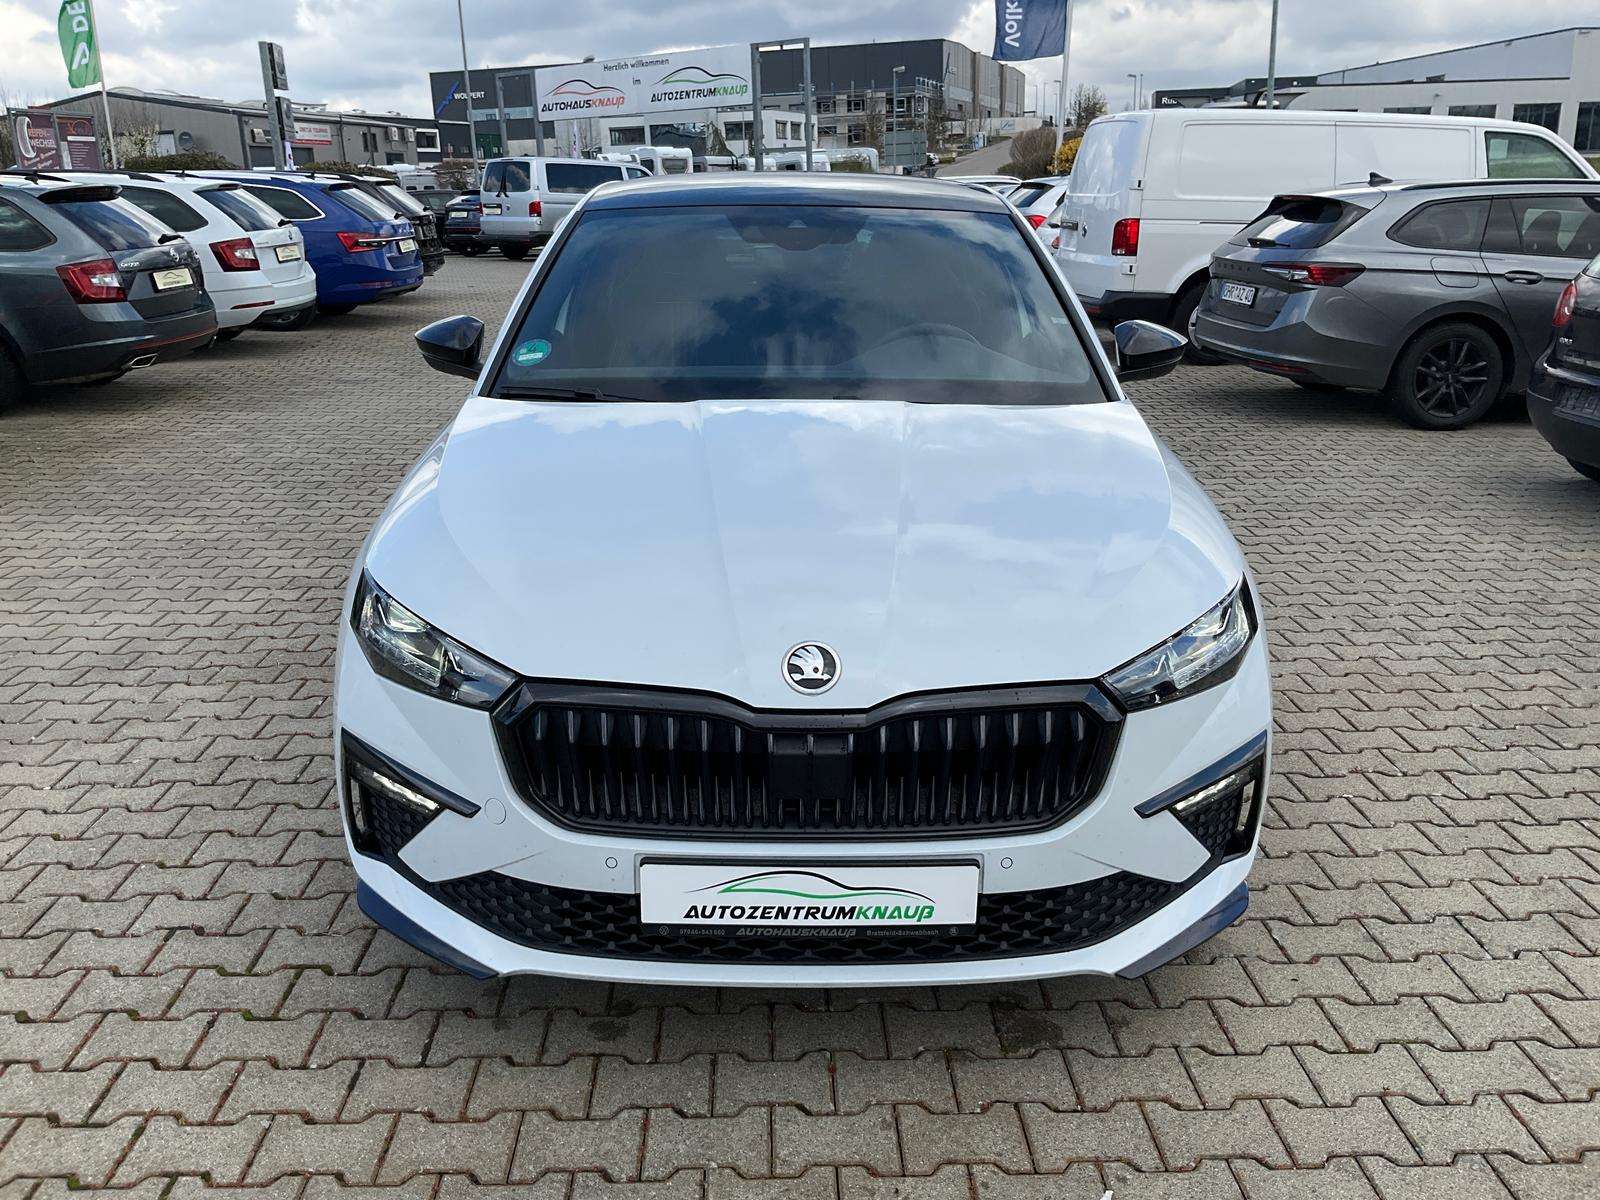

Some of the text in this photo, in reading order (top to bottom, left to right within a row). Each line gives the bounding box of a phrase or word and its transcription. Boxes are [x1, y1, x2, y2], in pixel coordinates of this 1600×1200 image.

[603, 58, 670, 72] Herzlich willkommen
[632, 77, 642, 86] im
